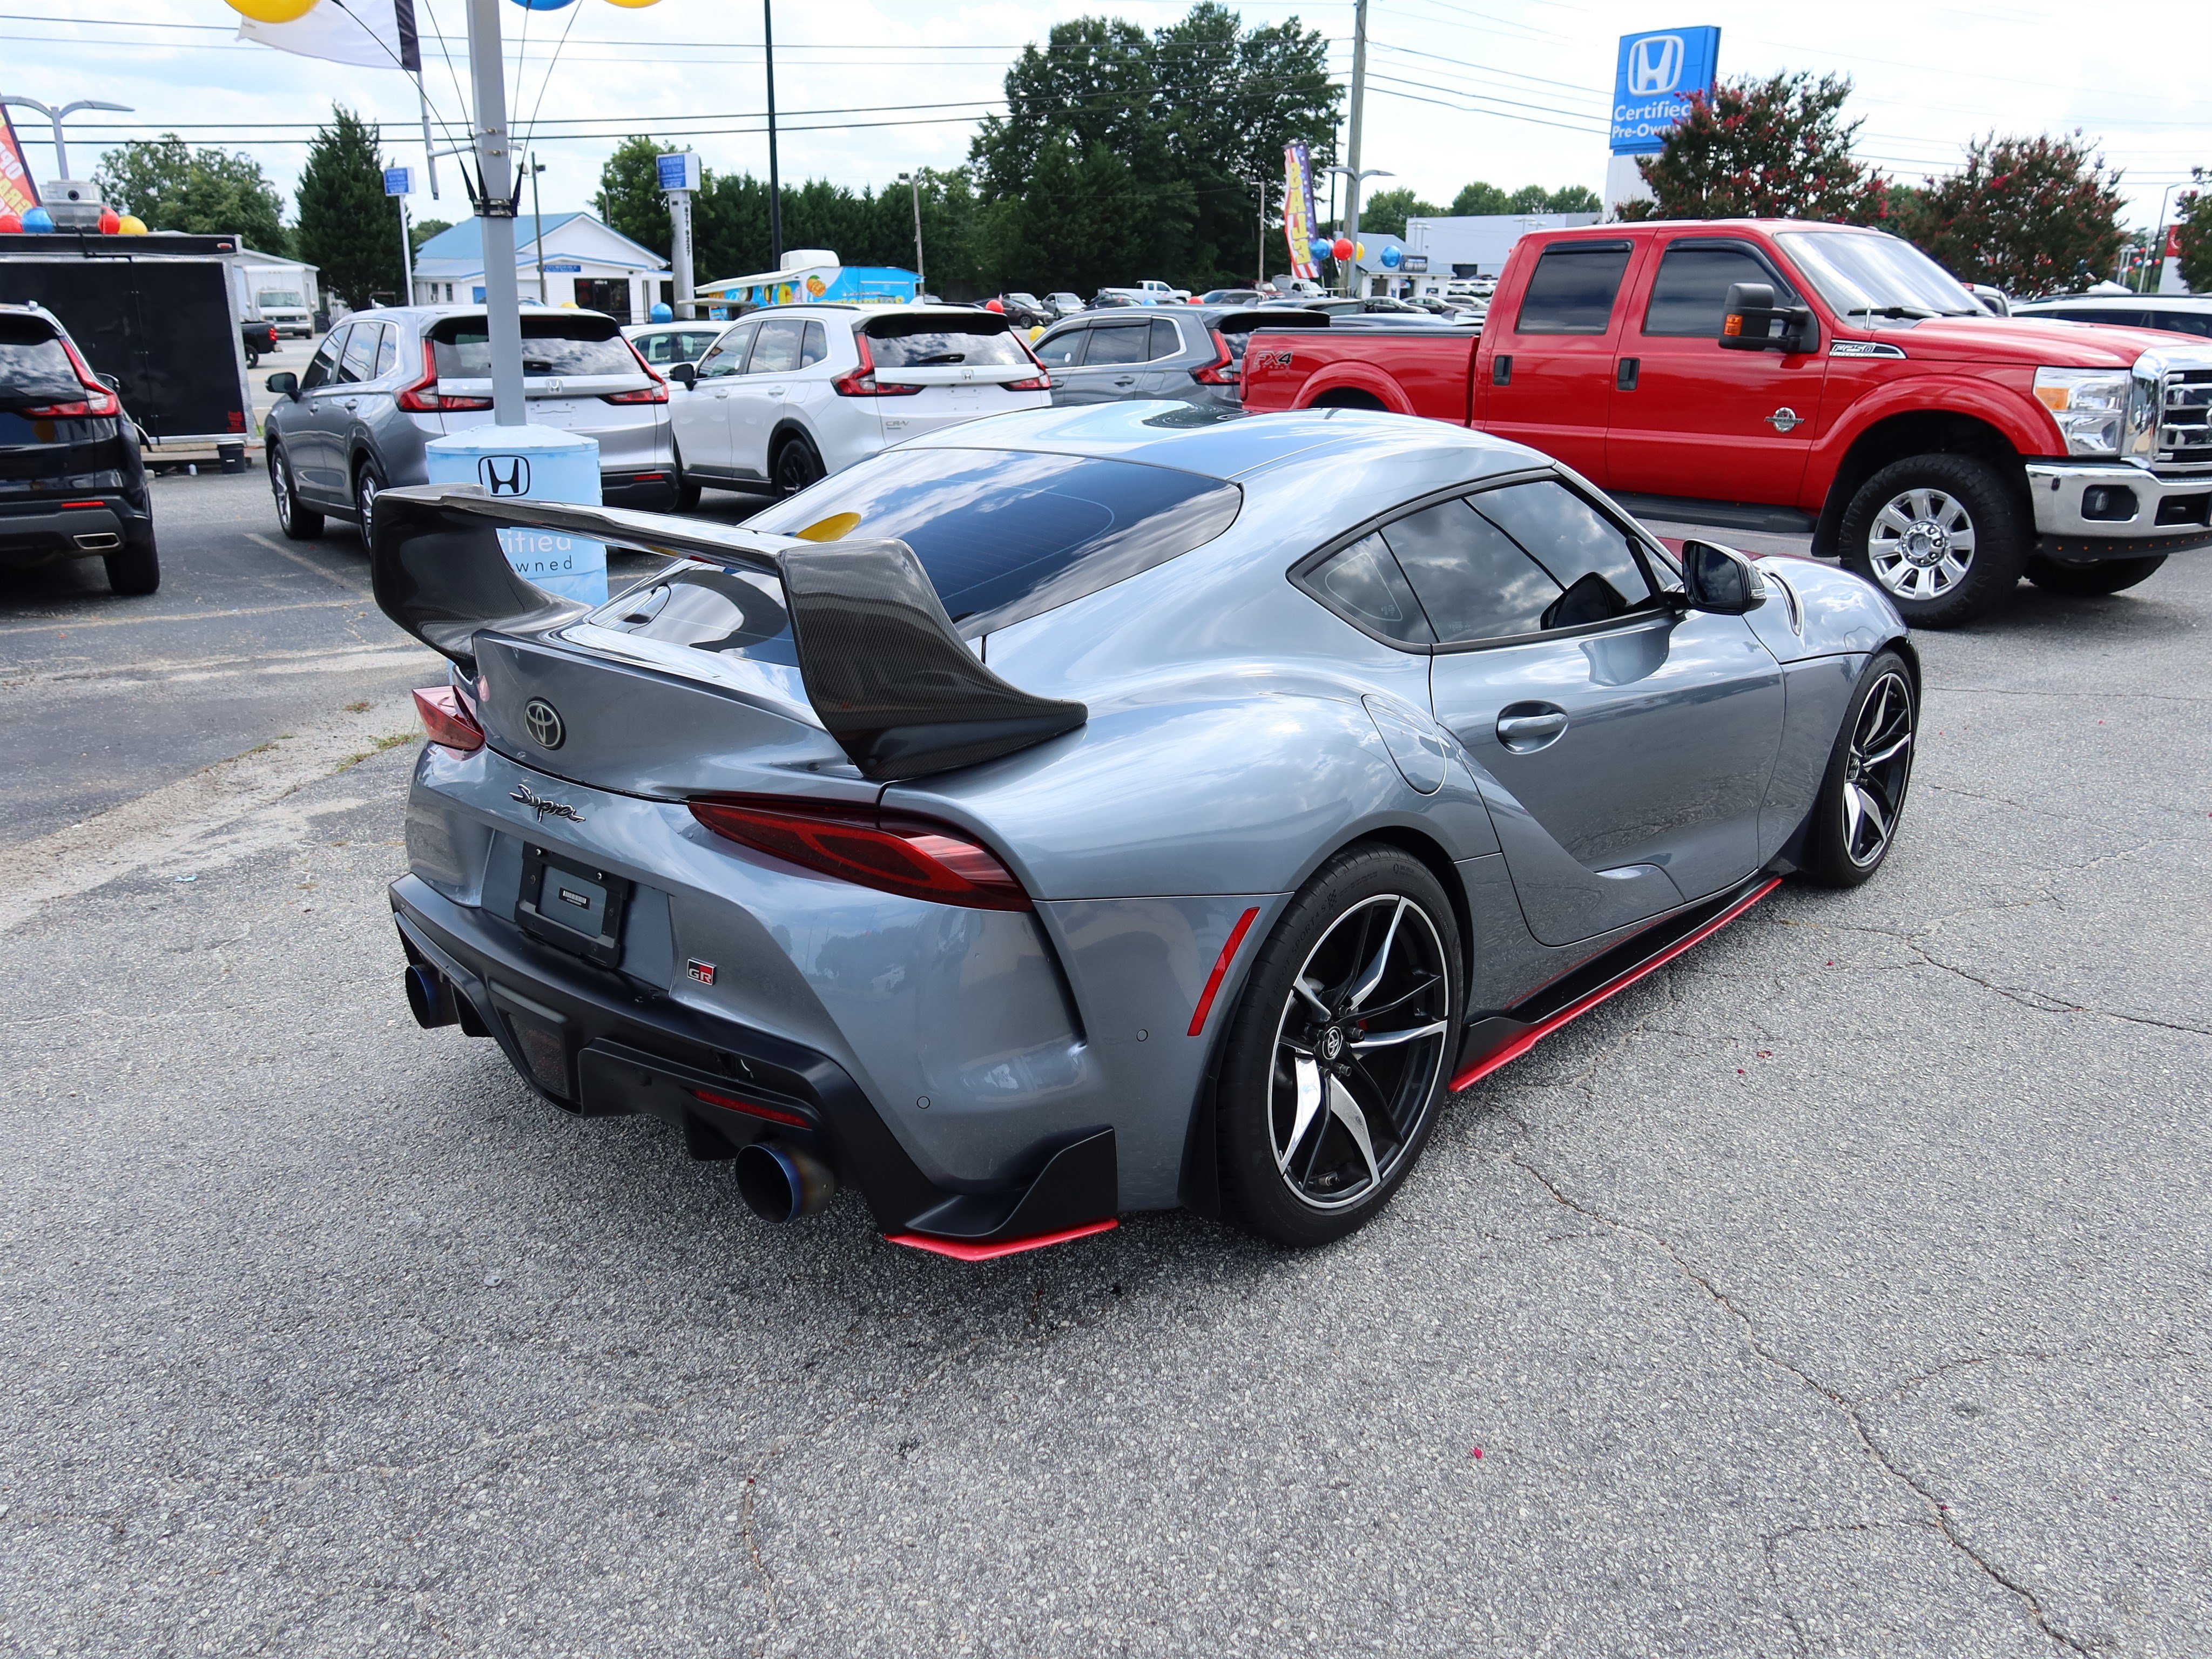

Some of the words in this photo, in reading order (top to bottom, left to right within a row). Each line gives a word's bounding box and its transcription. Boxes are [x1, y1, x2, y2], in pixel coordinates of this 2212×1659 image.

[1614, 100, 1694, 122] Certified
[1611, 123, 1682, 139] Pre-Own
[1253, 350, 1293, 366] FX4
[515, 555, 572, 572] wned
[509, 783, 586, 823] Supra
[1291, 917, 1316, 955] SPORT
[689, 968, 712, 983] GR
